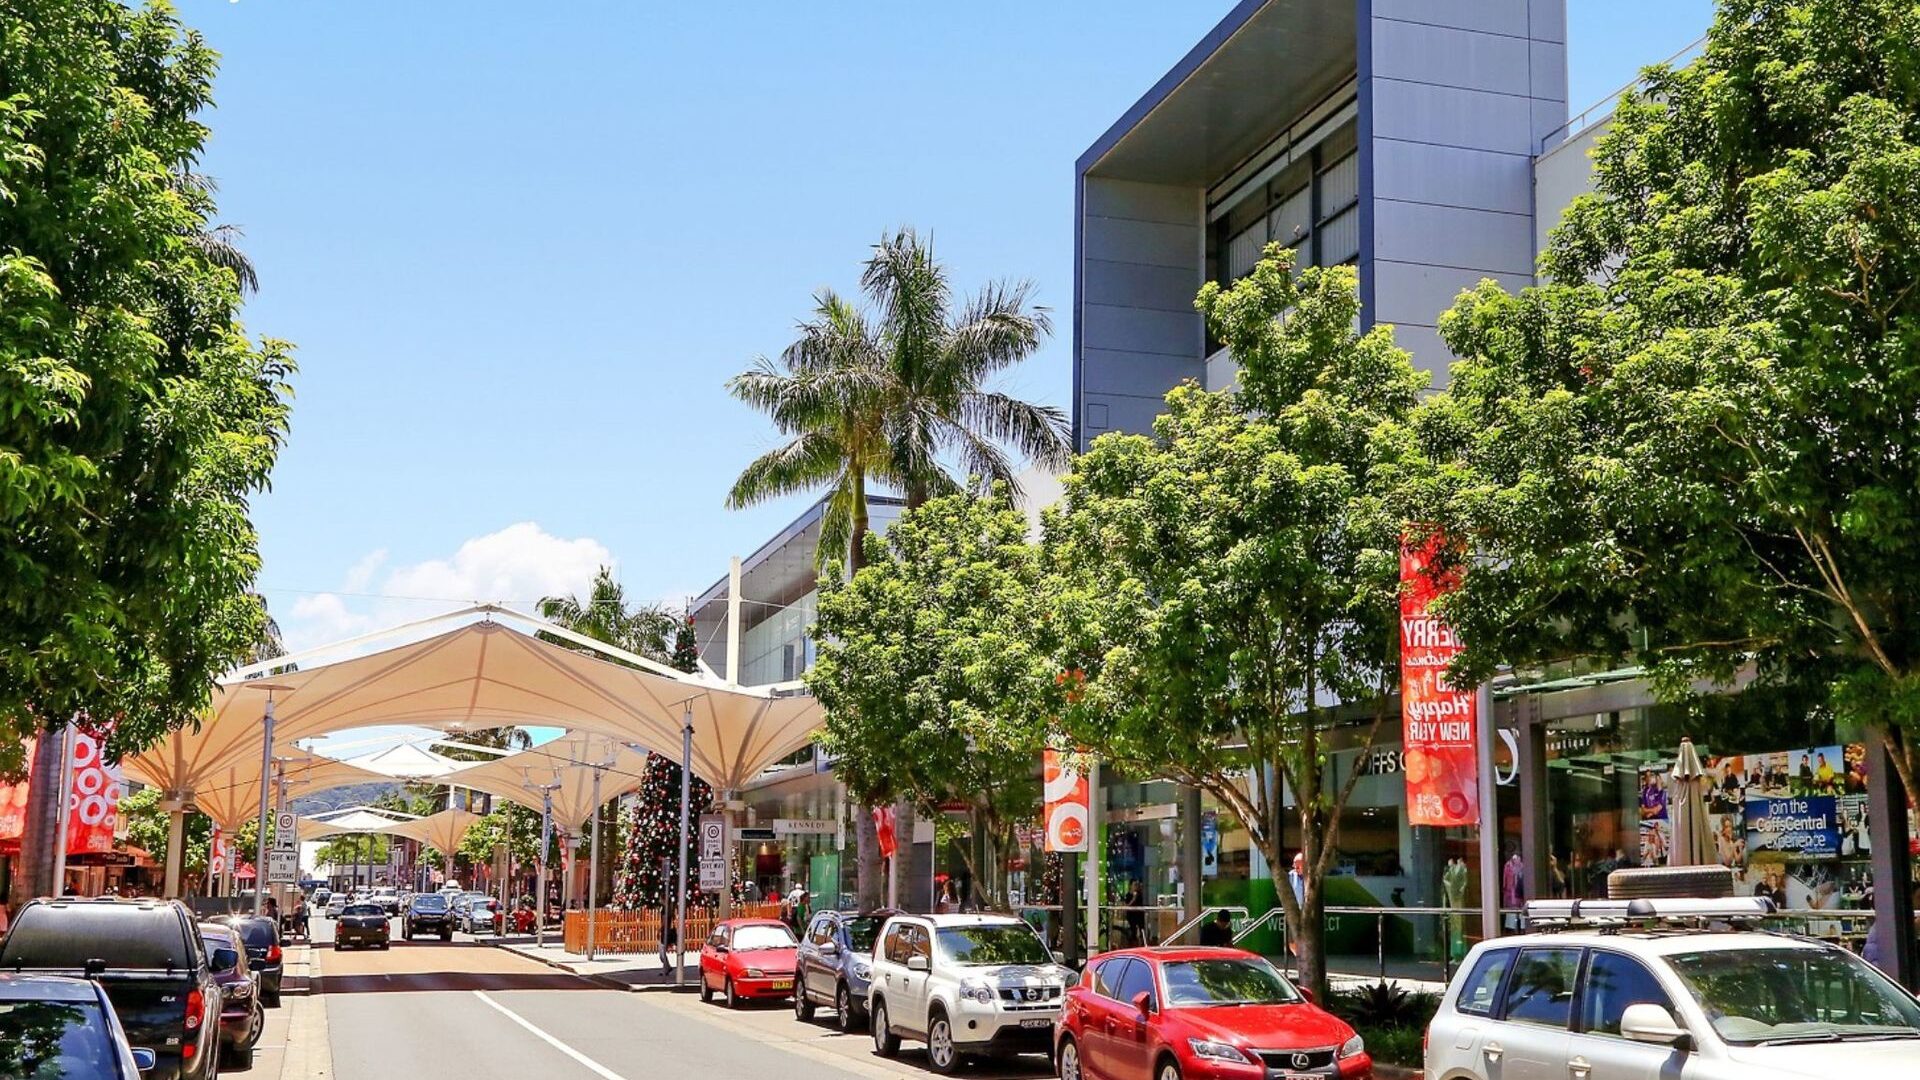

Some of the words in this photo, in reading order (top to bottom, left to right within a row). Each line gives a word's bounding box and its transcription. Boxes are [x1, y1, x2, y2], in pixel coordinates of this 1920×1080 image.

[1768, 800, 1788, 818] join
[1789, 799, 1808, 814] the
[1756, 814, 1827, 832] CoffsCentral
[1766, 834, 1826, 851] experience
